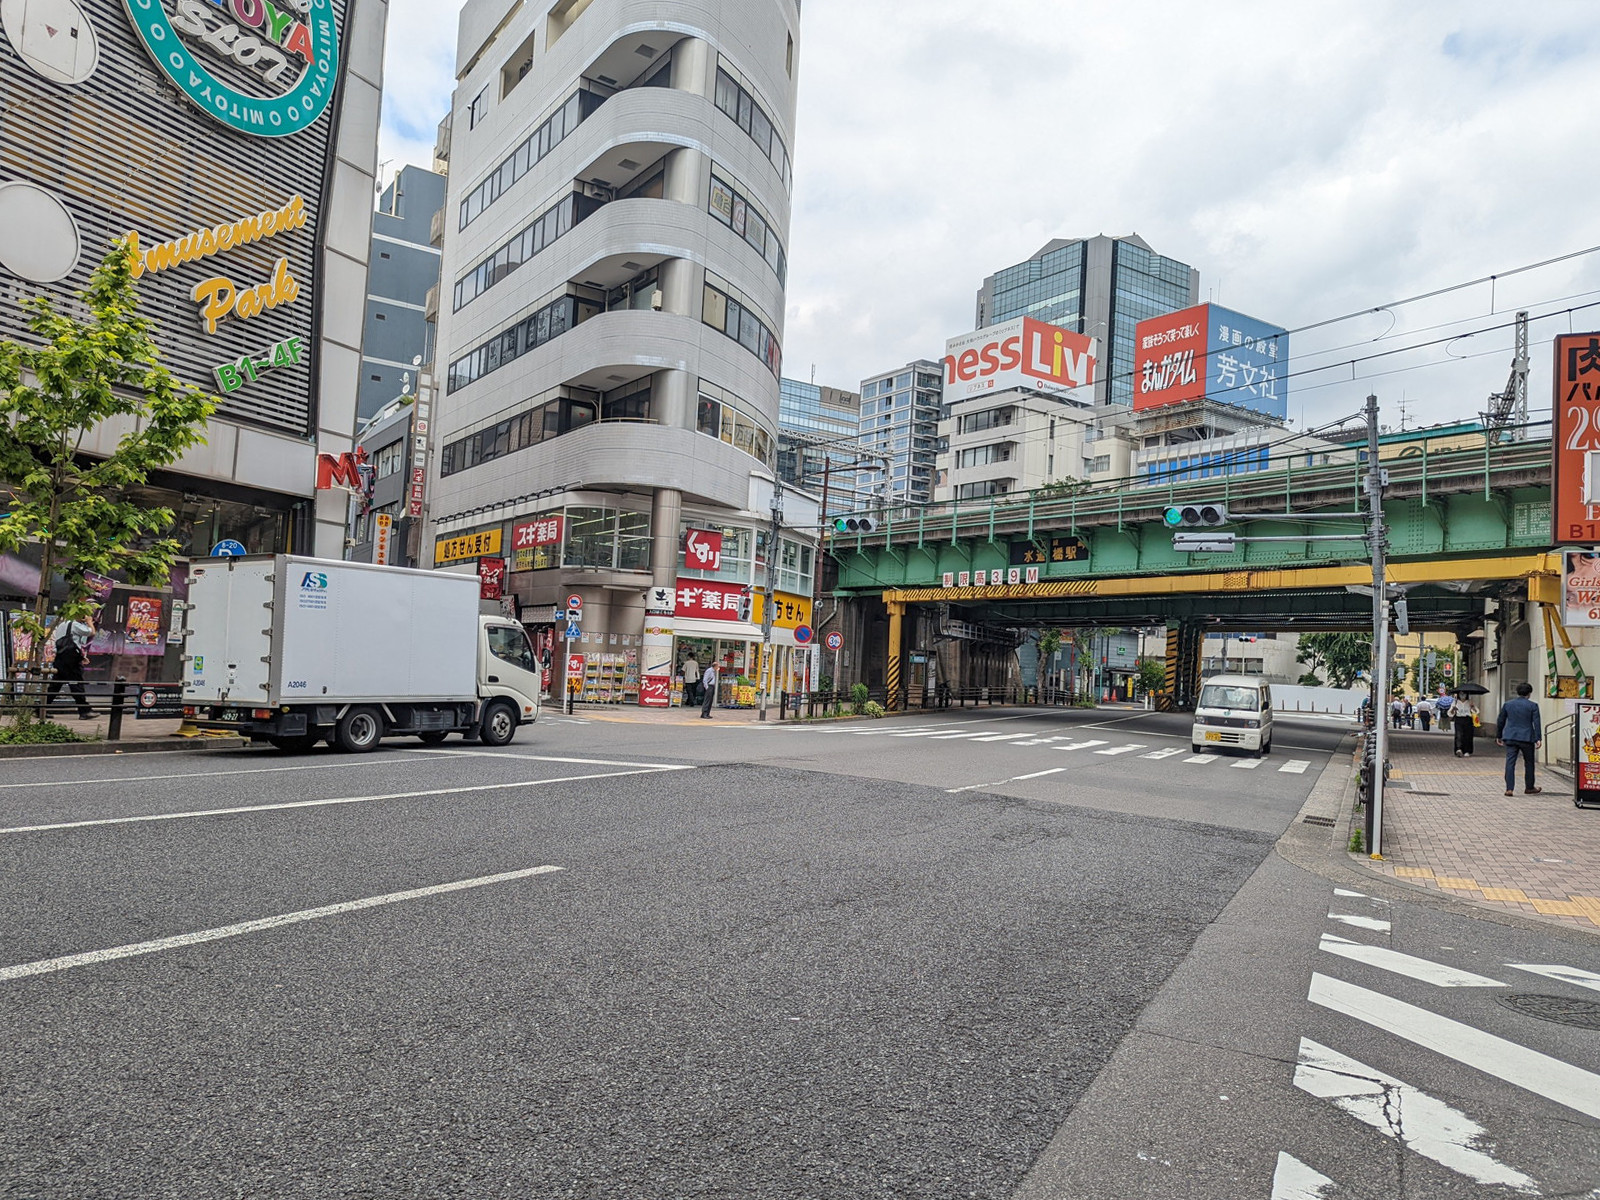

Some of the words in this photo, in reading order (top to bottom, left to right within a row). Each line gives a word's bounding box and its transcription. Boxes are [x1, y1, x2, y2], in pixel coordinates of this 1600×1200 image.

[191, 257, 300, 335] Park
[1216, 353, 1278, 400] 芳文社
[443, 532, 491, 559] 処方せん受付
[517, 520, 557, 546] スギ薬局
[686, 531, 720, 569] くすり
[676, 587, 739, 612] ギ薬局
[288, 681, 307, 689] A2046
